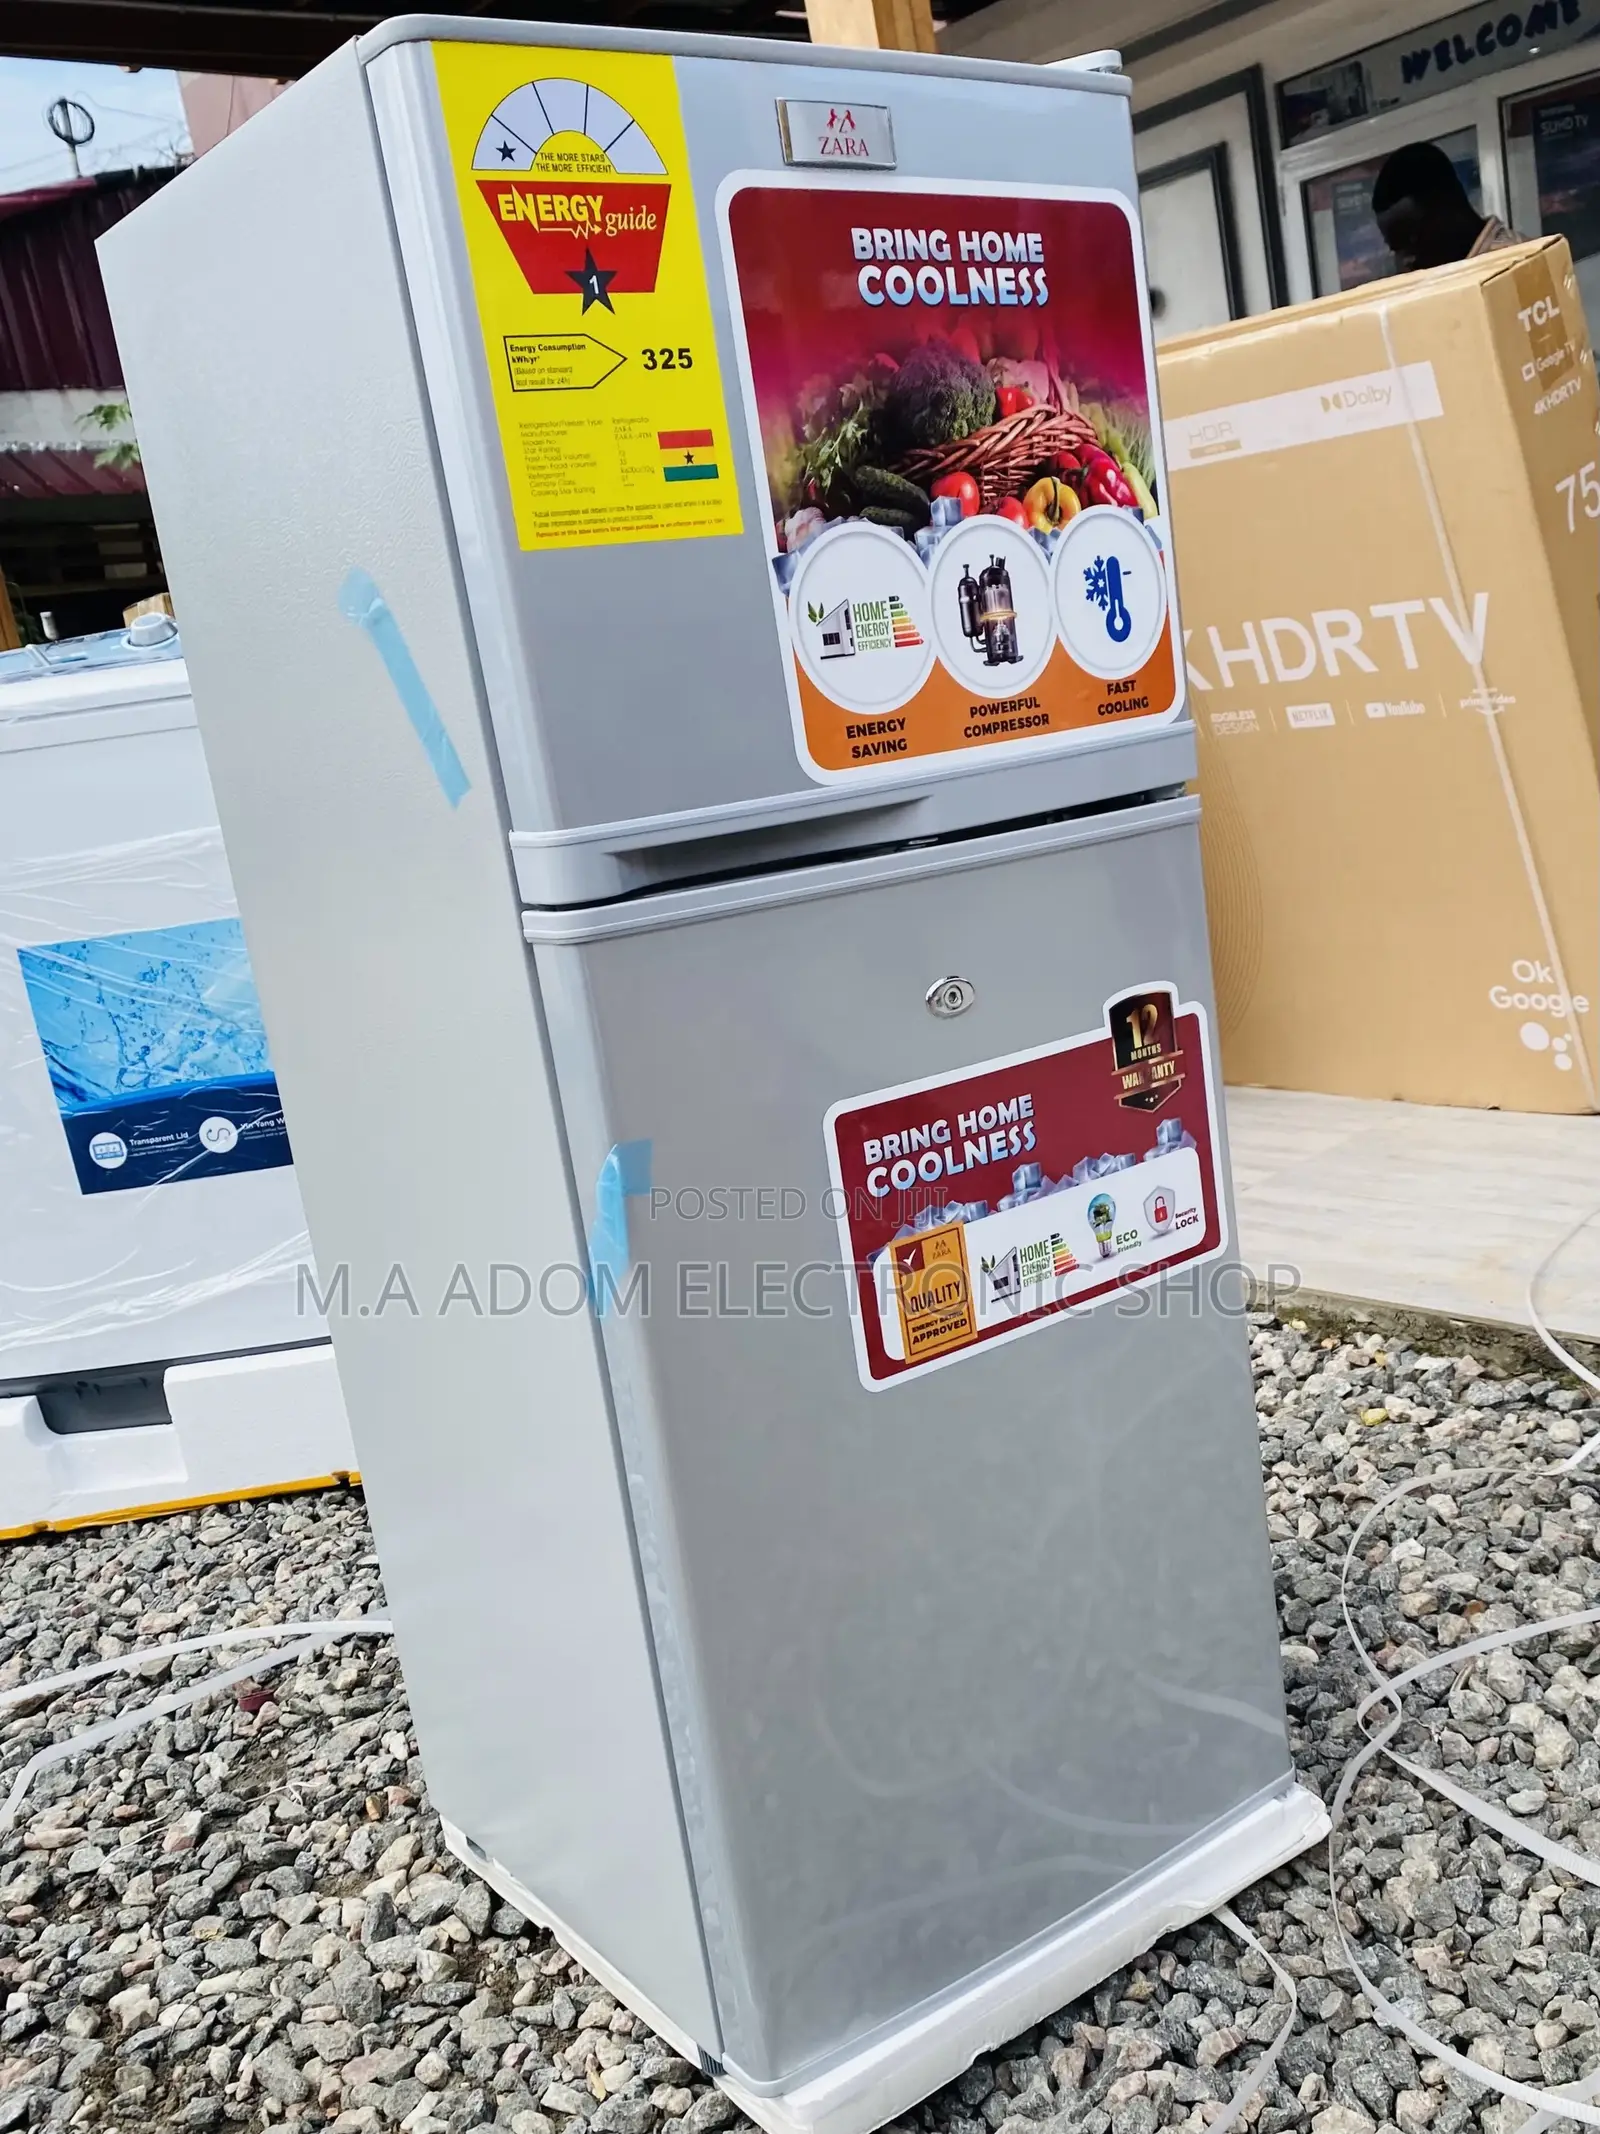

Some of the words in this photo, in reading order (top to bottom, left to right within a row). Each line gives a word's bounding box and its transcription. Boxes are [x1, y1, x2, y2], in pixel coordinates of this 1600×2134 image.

[1401, 0, 1580, 84] WELCOME
[540, 152, 554, 161] THE
[557, 153, 579, 162] MORE
[581, 154, 605, 162] STARS
[818, 136, 869, 157] ZARA
[536, 163, 551, 172] THE
[552, 163, 572, 172] MORE
[577, 164, 612, 174] EFFICIENT
[497, 184, 604, 233] ENERGY
[605, 205, 657, 237] guide
[850, 227, 952, 262] BRING
[958, 230, 1044, 264] HOME
[588, 275, 600, 295] 1
[857, 264, 1049, 307] COOLNESS
[1517, 295, 1561, 332] TCL
[510, 344, 536, 353] Energy
[538, 343, 586, 352] Consumption
[1537, 348, 1565, 371] Google
[1564, 339, 1575, 355] TV
[642, 348, 693, 371] 325
[1342, 385, 1393, 409] Dolby
[1188, 420, 1235, 444] HDR
[1555, 461, 1600, 534] 75
[852, 600, 888, 622] HOME
[856, 621, 890, 639] ENERGY
[858, 638, 892, 651] EFFICIENCY
[1107, 680, 1136, 696] FAST
[969, 696, 1041, 719] POWERFUL
[1097, 696, 1149, 716] COOLING
[1292, 708, 1329, 723] NETFLIX
[1385, 701, 1426, 716] YouTube
[845, 717, 907, 740] ENERGY
[964, 714, 1049, 739] COMPRESSOR
[1214, 721, 1260, 736] DESIGN
[851, 738, 908, 760] SAVING
[1512, 959, 1554, 984] Ok
[1489, 985, 1590, 1018] Googe
[1126, 1004, 1158, 1049] 12
[1130, 1043, 1162, 1061] MONTHS
[1122, 1061, 1175, 1089] WARANTY
[255, 1120, 275, 1128] Yang
[863, 1119, 951, 1165] BRING
[957, 1094, 1034, 1137] HOME
[129, 1135, 174, 1147] Transparent
[176, 1132, 189, 1140] Lid
[866, 1121, 1036, 1198] COOLNESS
[1175, 1207, 1197, 1219] Security
[1175, 1214, 1199, 1230] LOCK
[1116, 1229, 1138, 1245] ECO
[1117, 1240, 1142, 1253] Friendly
[1019, 1239, 1050, 1264] HOME
[1022, 1258, 1051, 1278] ENERGY
[910, 1280, 961, 1313] QUALITY
[912, 1320, 939, 1333] ENERGY
[912, 1318, 967, 1345] APPROVED
